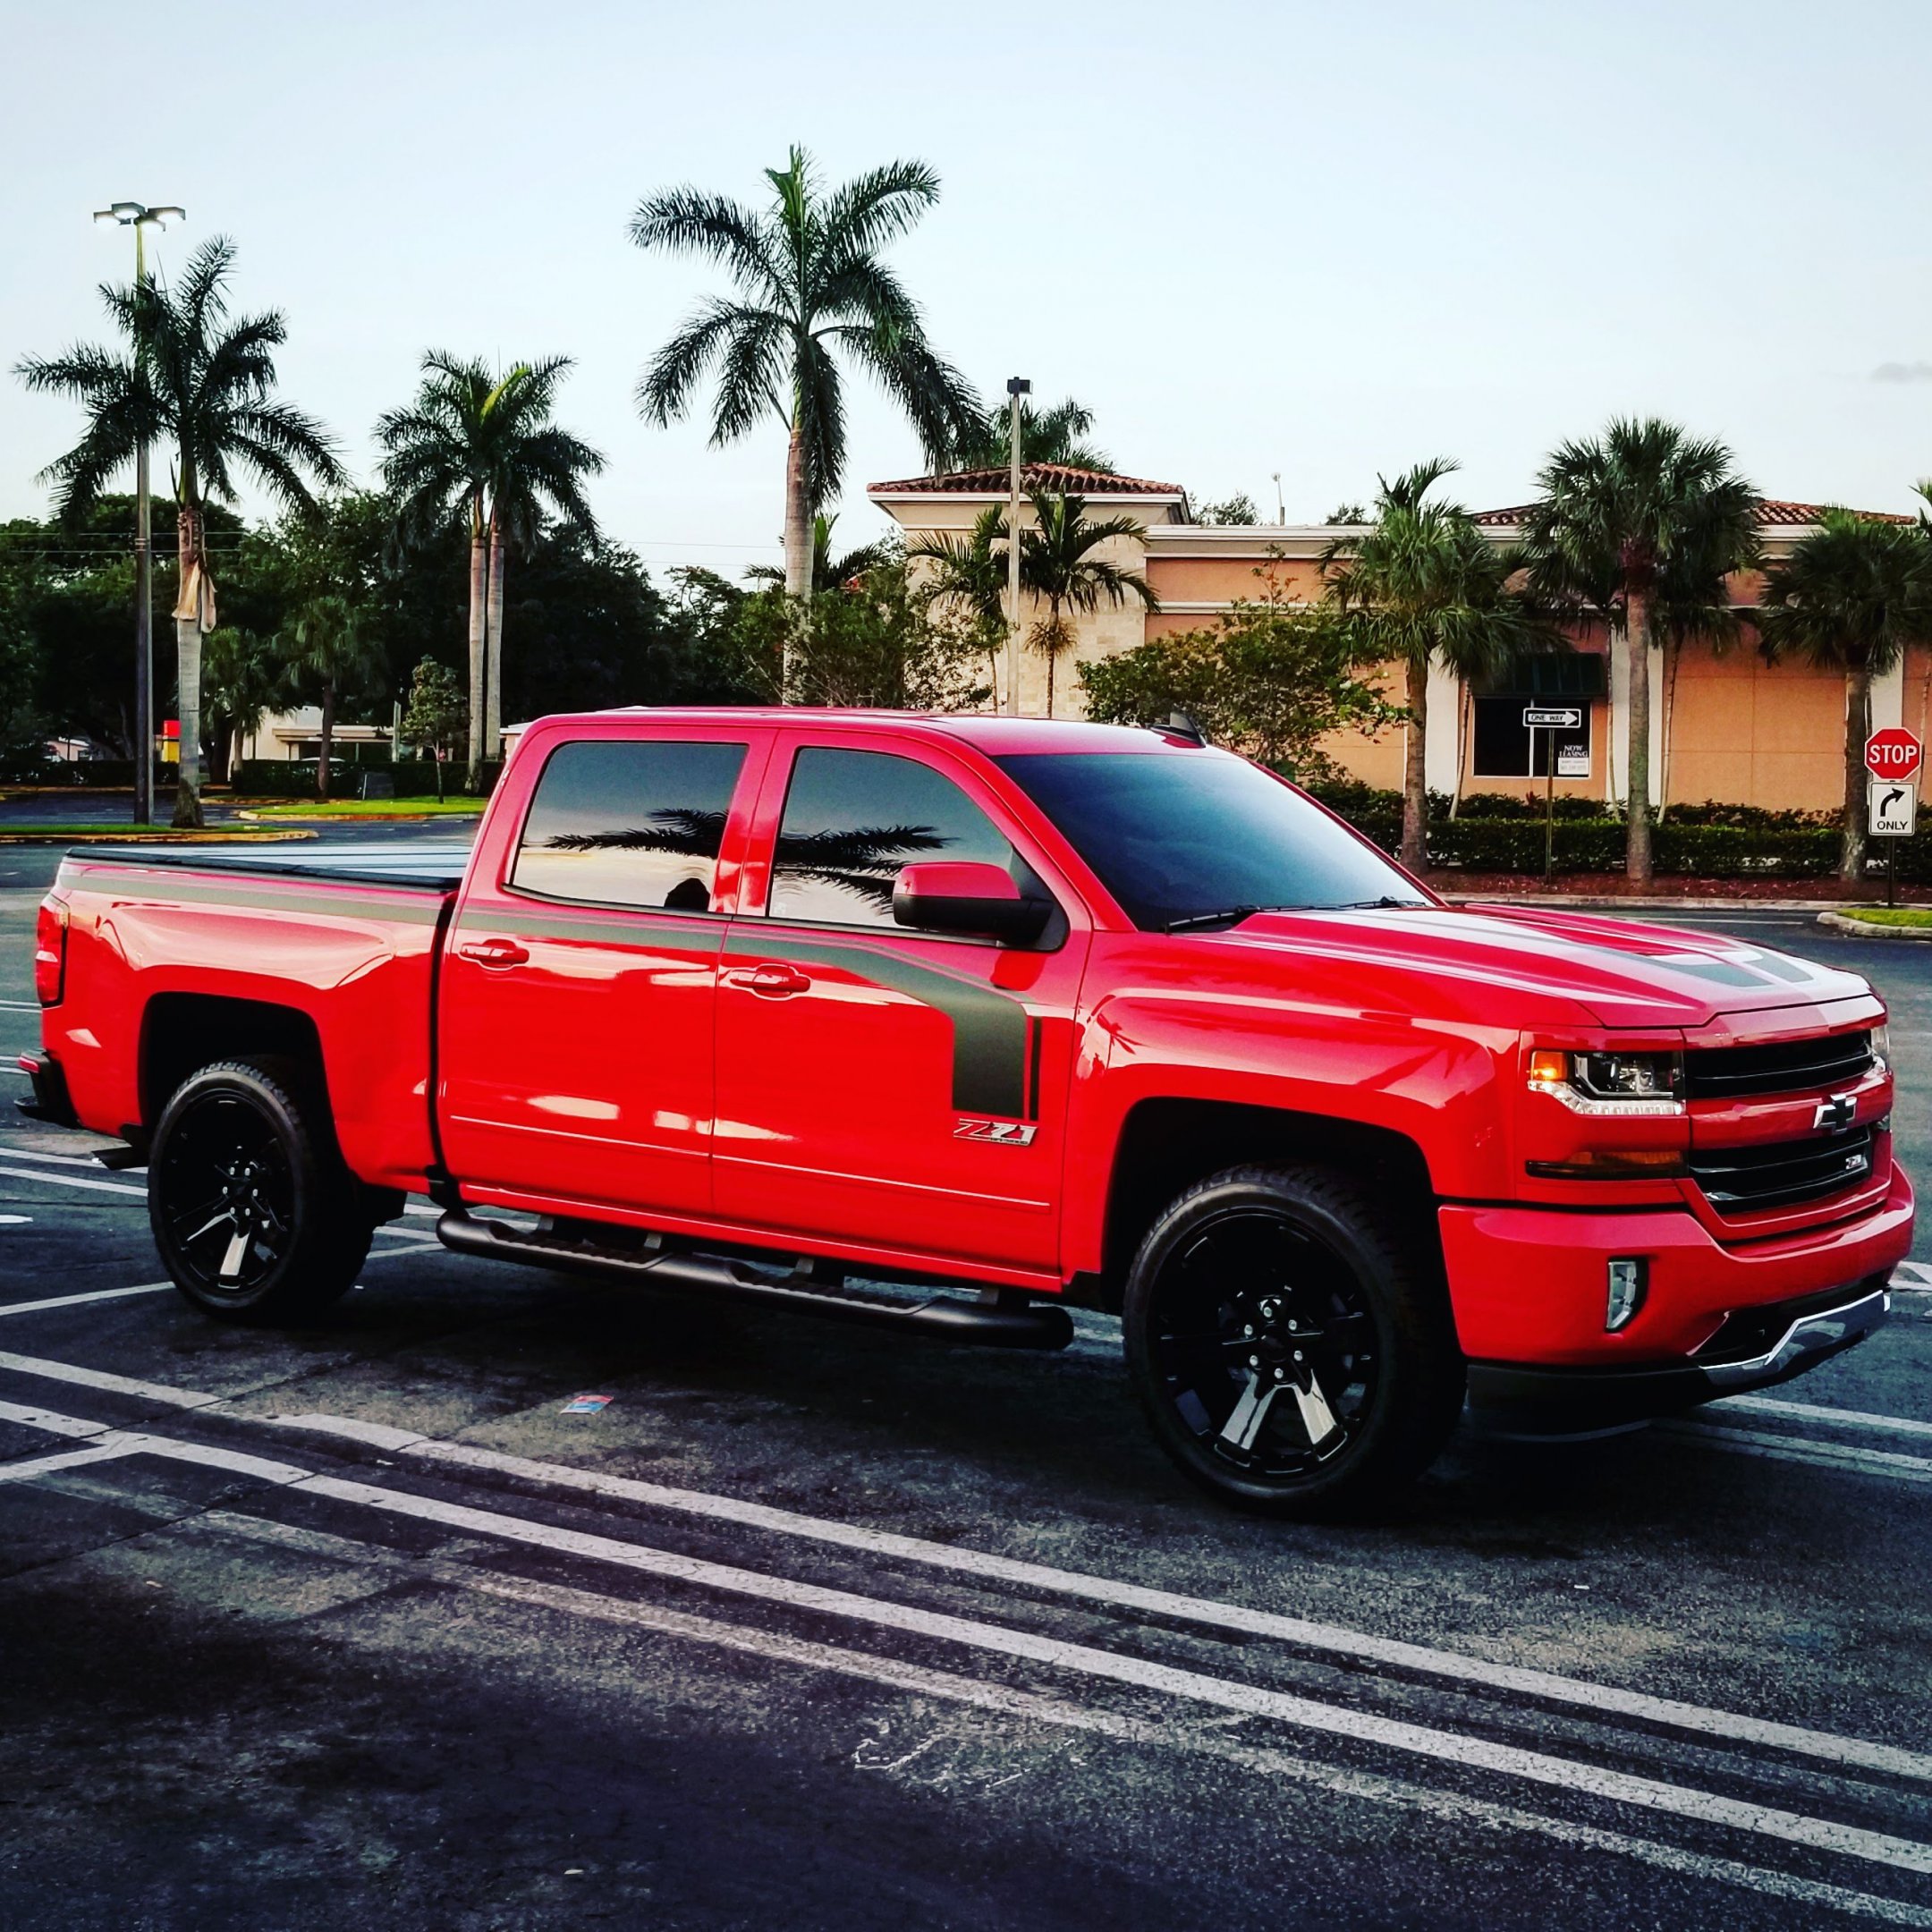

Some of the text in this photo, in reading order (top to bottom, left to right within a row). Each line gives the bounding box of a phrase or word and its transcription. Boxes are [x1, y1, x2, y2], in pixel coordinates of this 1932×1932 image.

[1531, 714, 1546, 722] ONE
[1868, 744, 1918, 764] STOP
[1877, 820, 1908, 830] ONLY
[953, 1118, 1038, 1146] Z71
